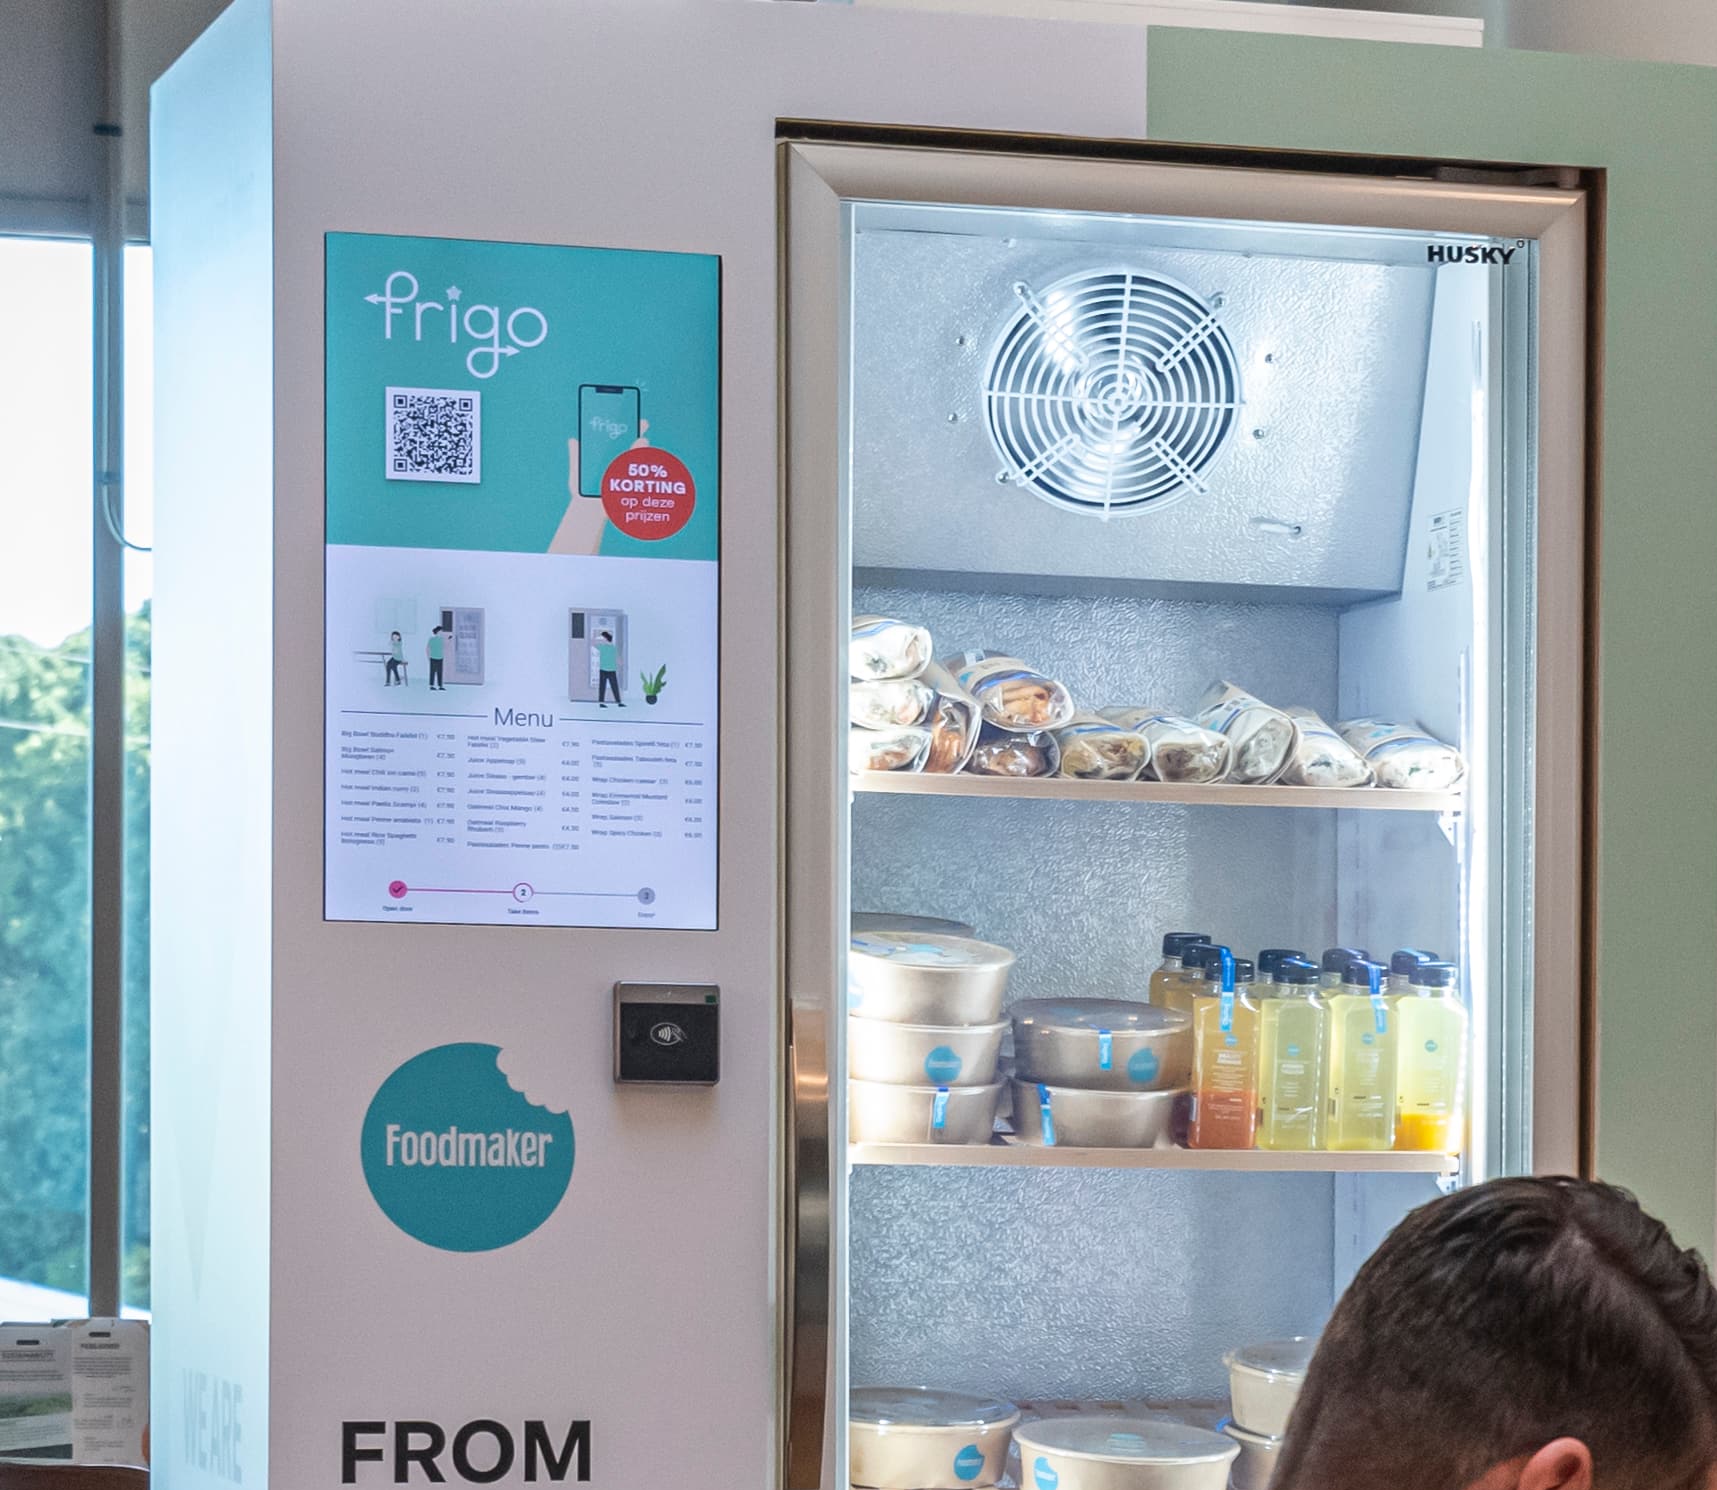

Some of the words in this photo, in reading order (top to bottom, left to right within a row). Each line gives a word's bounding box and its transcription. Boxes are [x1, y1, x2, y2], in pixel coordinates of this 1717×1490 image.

[1427, 245, 1515, 265] HUSKY
[364, 271, 548, 378] frigo
[590, 415, 628, 439] frigo
[627, 463, 668, 478] 50%
[609, 478, 686, 494] KORTING
[620, 497, 639, 509] op
[642, 496, 675, 509] deze
[625, 510, 670, 524] prijzen
[494, 707, 554, 728] Menu
[520, 888, 527, 896] 2
[385, 1124, 553, 1168] Foodmaker
[182, 1368, 206, 1470] WE
[210, 1374, 242, 1484] ARE
[342, 1419, 591, 1484] FROM
